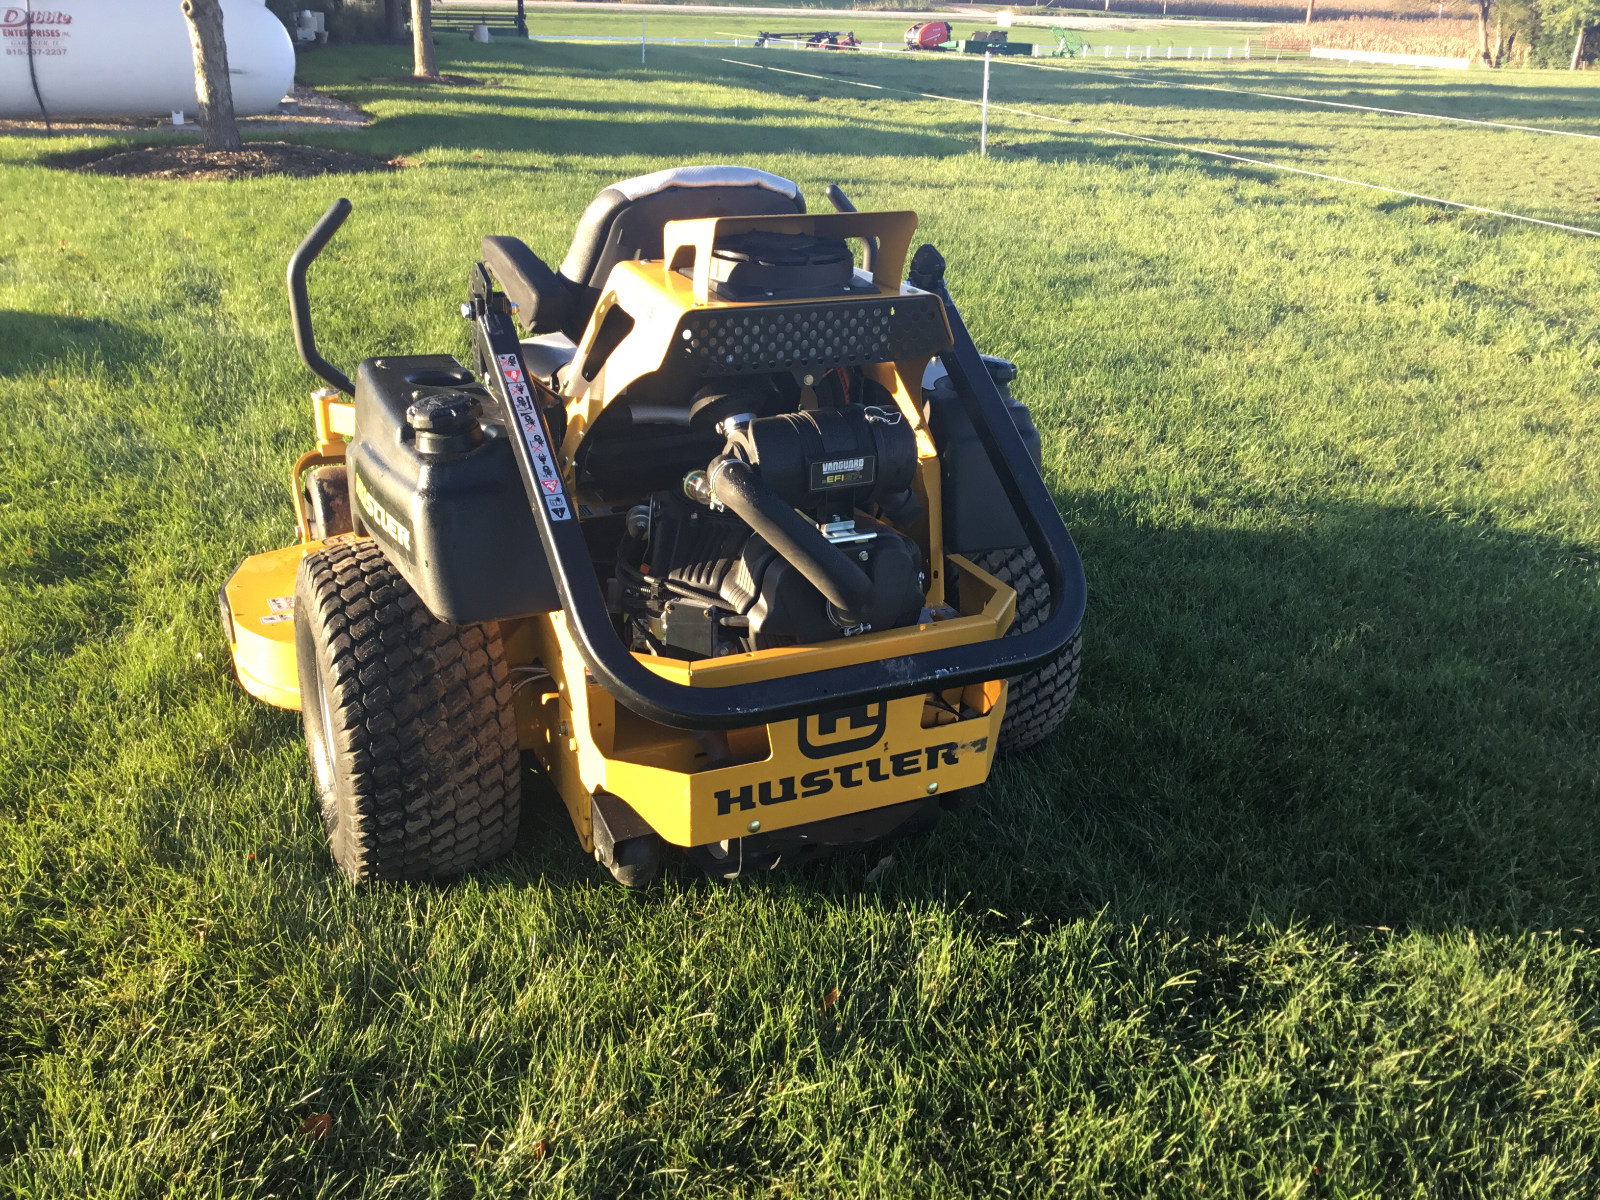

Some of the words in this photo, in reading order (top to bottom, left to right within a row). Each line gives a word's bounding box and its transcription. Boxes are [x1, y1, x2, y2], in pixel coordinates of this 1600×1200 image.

[2, 29, 60, 37] ENTERPRISES
[823, 459, 864, 471] VANGUARD
[827, 474, 844, 483] EFI
[714, 742, 959, 816] HUSTLER
